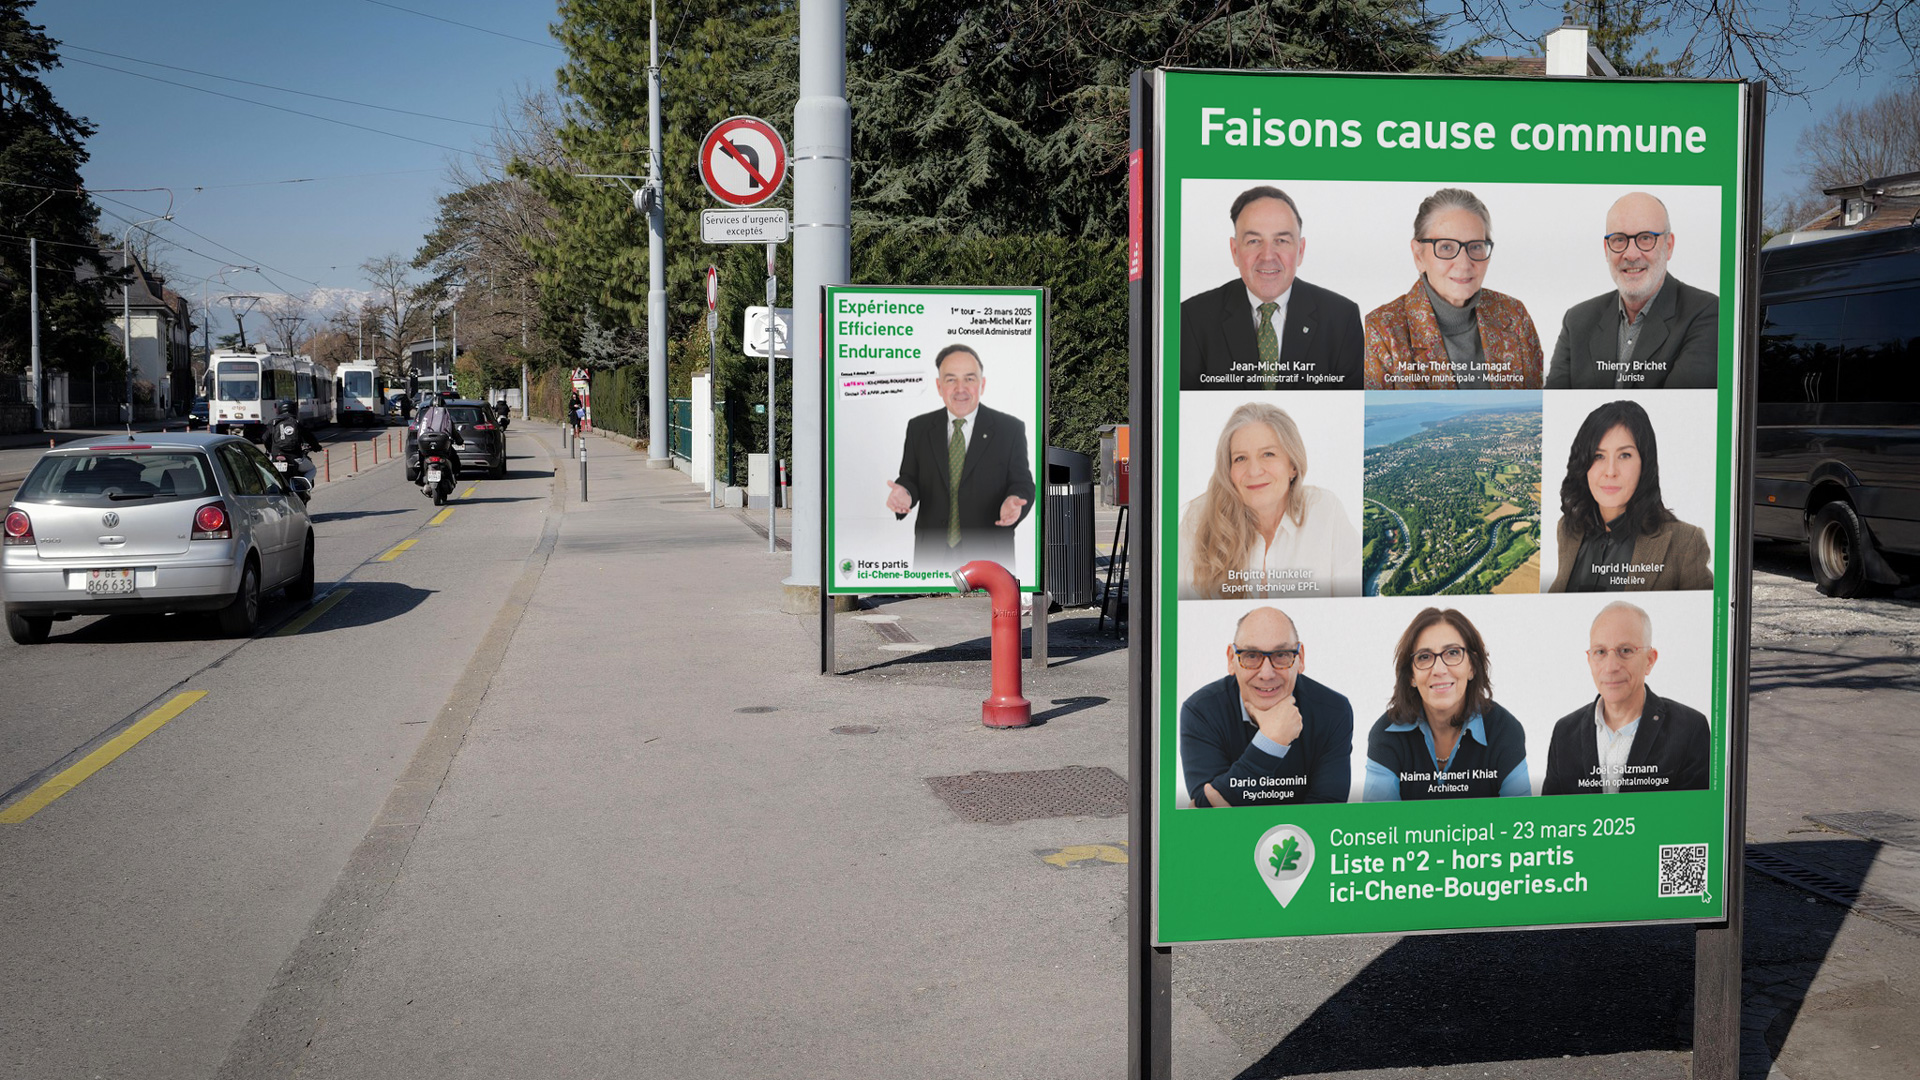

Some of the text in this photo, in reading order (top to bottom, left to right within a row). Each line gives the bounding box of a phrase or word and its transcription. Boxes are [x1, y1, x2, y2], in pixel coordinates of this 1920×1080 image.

[1201, 107, 1706, 154] Faisons cause commune
[706, 215, 784, 225] Services d'urgence
[726, 227, 762, 236] exceptés
[839, 299, 924, 317] Expérience
[839, 321, 913, 336] Efficience
[958, 327, 984, 335] Conseil
[839, 344, 921, 358] Endurance
[1230, 361, 1316, 371] Jean-Michel Karr
[1398, 361, 1511, 372] Marie-Thérèse Lamagat
[1596, 361, 1667, 372] Thierry Brichet
[1246, 374, 1299, 383] administratif
[1306, 374, 1345, 384] Ingénieur
[1384, 373, 1430, 382] Conseillère
[1432, 374, 1475, 384] municipale
[1483, 373, 1524, 382] Médiatrice
[1617, 373, 1645, 382] Juriste
[858, 560, 908, 570] Hors partis
[1592, 563, 1664, 575] Ingrid Hunkeler
[105, 569, 116, 578] GE
[858, 570, 952, 580] ici-Chene-Bougeries.
[1228, 569, 1313, 581] Brigitte Hunkeler
[89, 580, 132, 591] 866 633
[1610, 576, 1645, 585] Hôtelière
[1222, 582, 1319, 594] Experte technique EPFL
[1400, 769, 1498, 781] Naima Mameri Khiat
[1590, 765, 1658, 775] Joël Salzmann
[1230, 775, 1307, 787] Dario Giacomini
[1578, 777, 1669, 787] Médecin ophtalmologue
[1428, 784, 1469, 792] Architecte
[1243, 790, 1294, 801] Psychologue
[1330, 827, 1398, 847] Conseil
[1405, 823, 1494, 846] municipal
[1512, 822, 1534, 839] 23
[1541, 822, 1587, 838] mars
[1592, 817, 1635, 836] 2025
[1330, 854, 1384, 874] Liste
[1452, 849, 1502, 869] hors
[1510, 845, 1574, 872] partis
[1330, 872, 1588, 902] ici-Chene-Bougeries.ch
